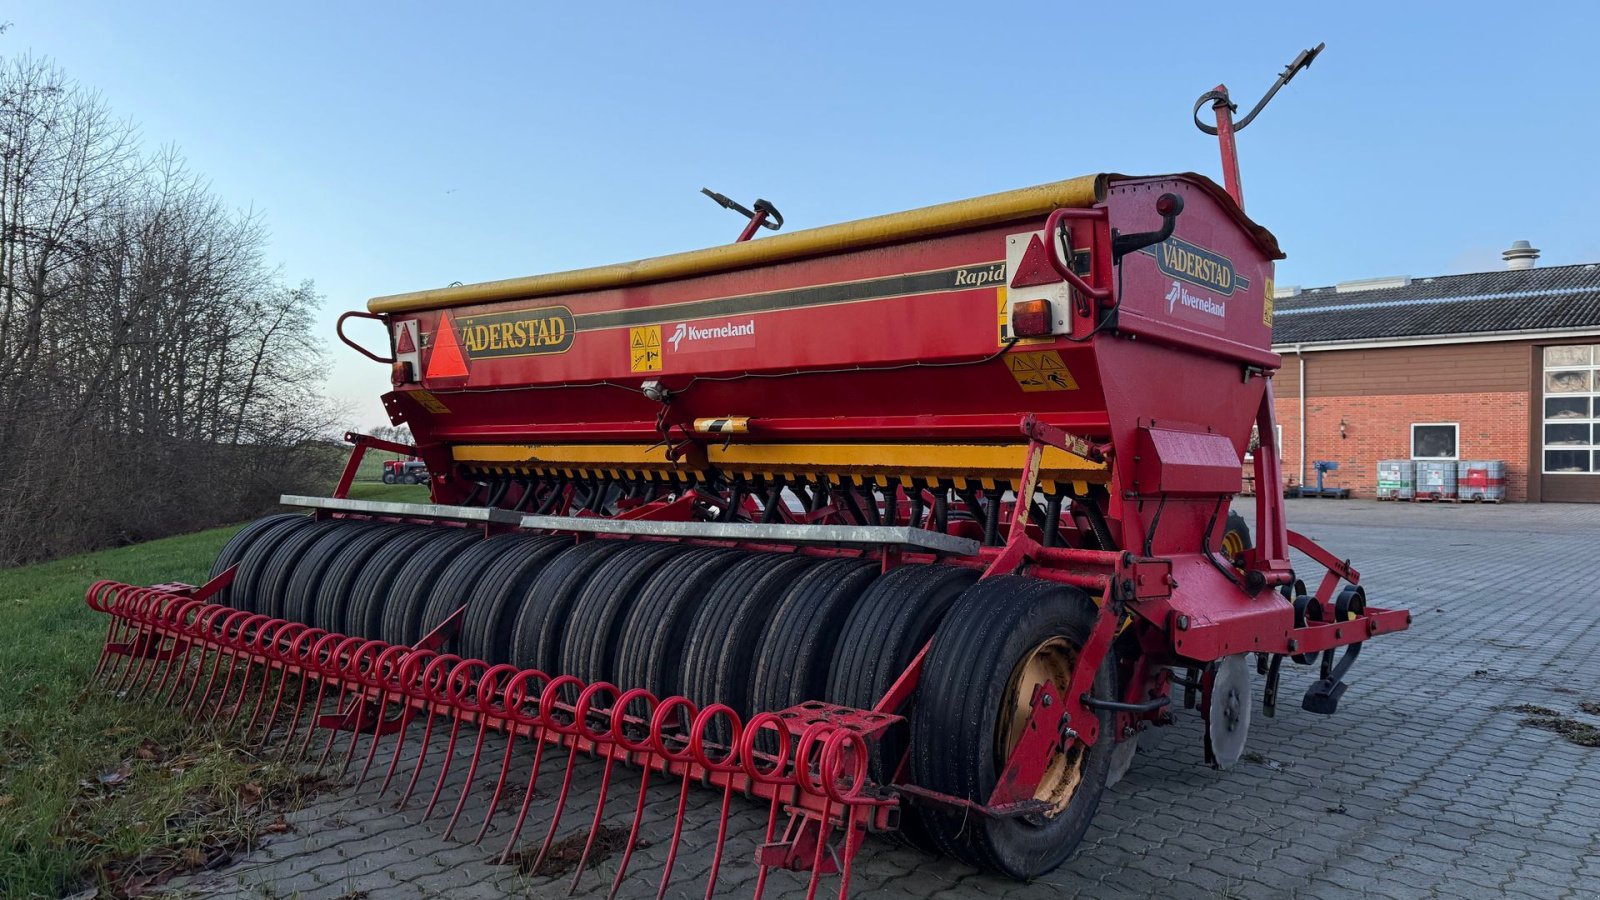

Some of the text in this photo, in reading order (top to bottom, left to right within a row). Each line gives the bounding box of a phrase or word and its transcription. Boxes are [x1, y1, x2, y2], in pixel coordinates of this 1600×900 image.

[954, 264, 1006, 286] Rapid
[1162, 240, 1230, 288] VÄDERSTAD
[1181, 288, 1225, 317] Kverneland
[688, 320, 754, 340] Kverneland
